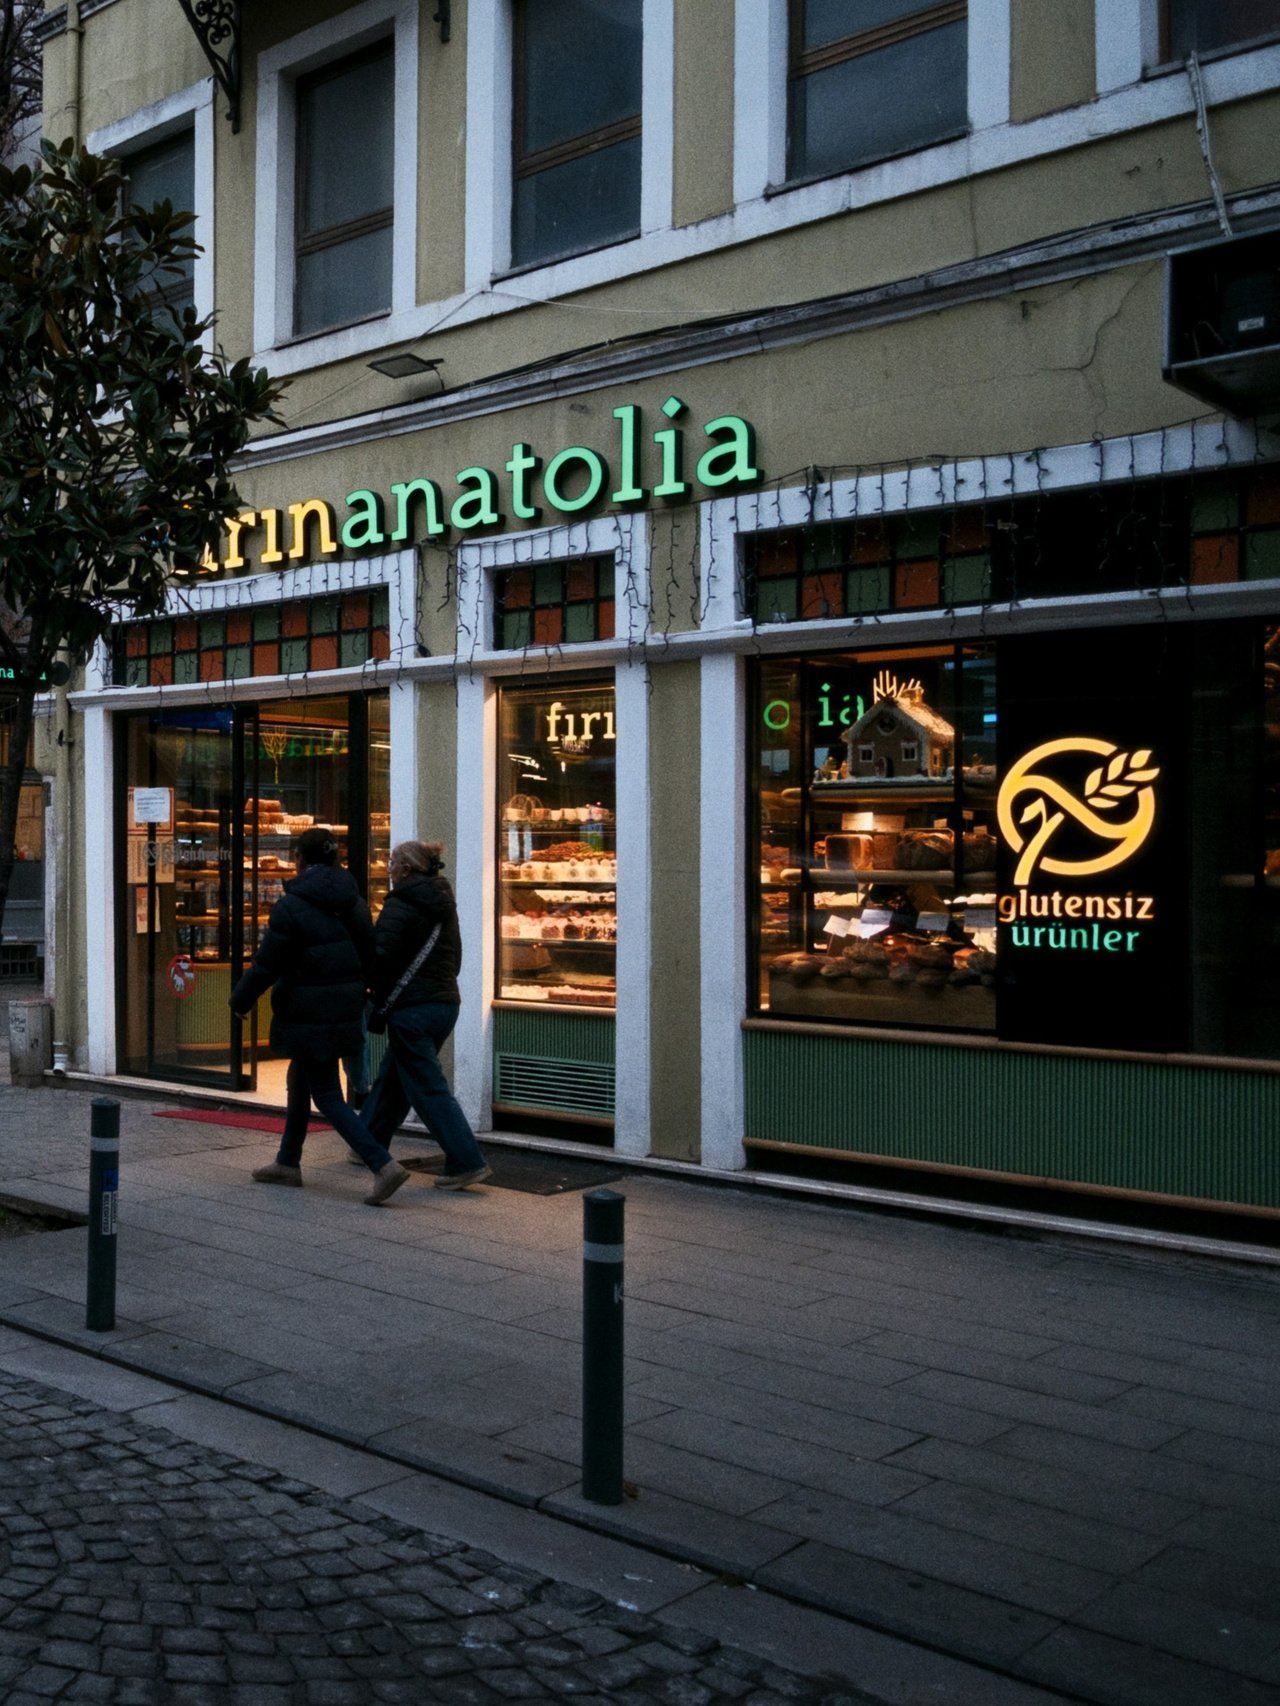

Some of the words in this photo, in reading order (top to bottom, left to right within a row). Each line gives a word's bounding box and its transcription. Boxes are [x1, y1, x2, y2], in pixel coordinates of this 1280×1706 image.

[171, 396, 767, 574] rınanatolia
[998, 888, 1155, 923] glutensiz
[1011, 920, 1141, 952] ürünler
